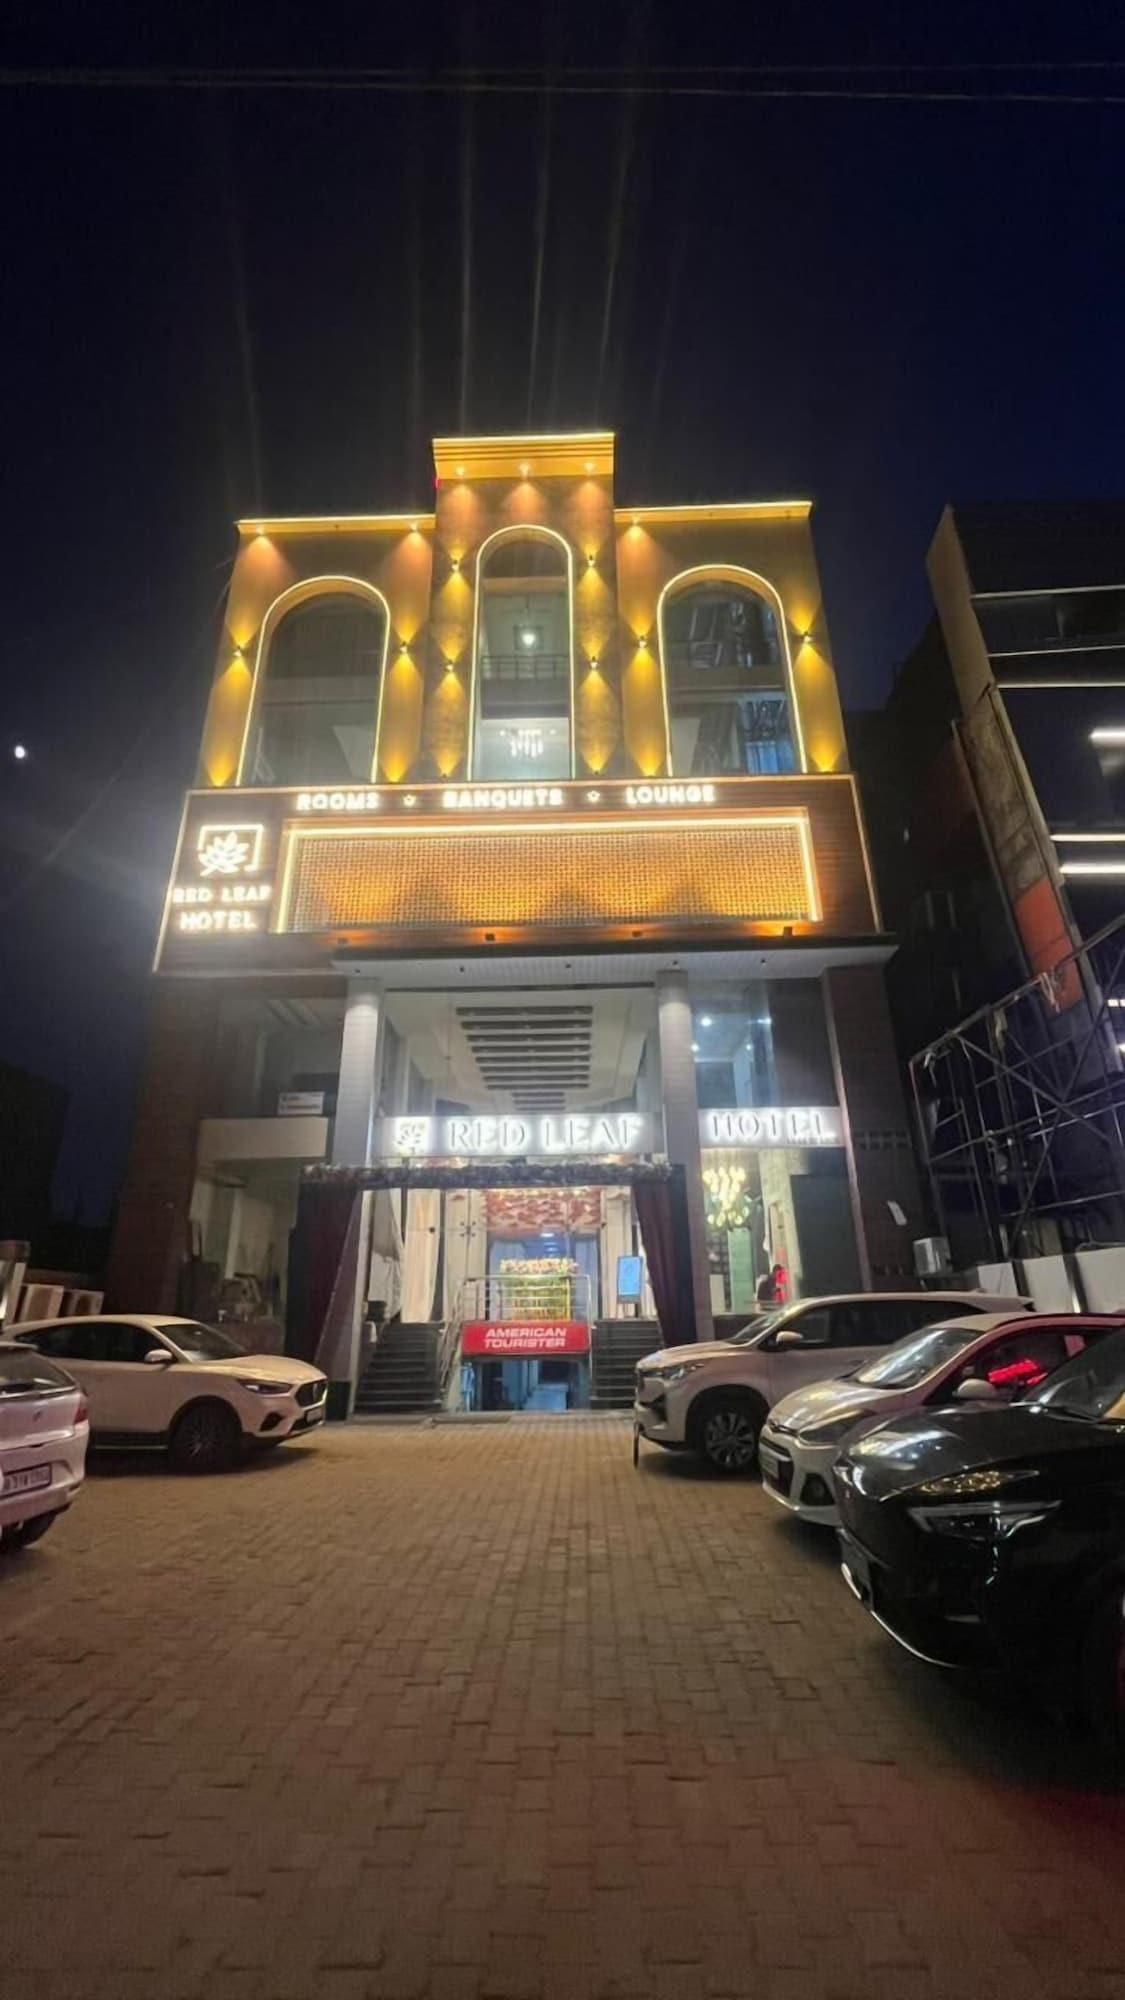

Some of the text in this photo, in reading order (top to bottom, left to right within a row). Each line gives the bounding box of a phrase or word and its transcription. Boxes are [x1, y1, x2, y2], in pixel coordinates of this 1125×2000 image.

[295, 783, 716, 811] ROOMS BANQUETS LOUNGE
[172, 885, 272, 904] RED LEAF
[179, 910, 258, 931] HOTEL
[449, 1111, 837, 1150] RED LEAF HOTEL
[484, 1326, 568, 1339] AMERICAN
[484, 1337, 567, 1349] TOURISTER
